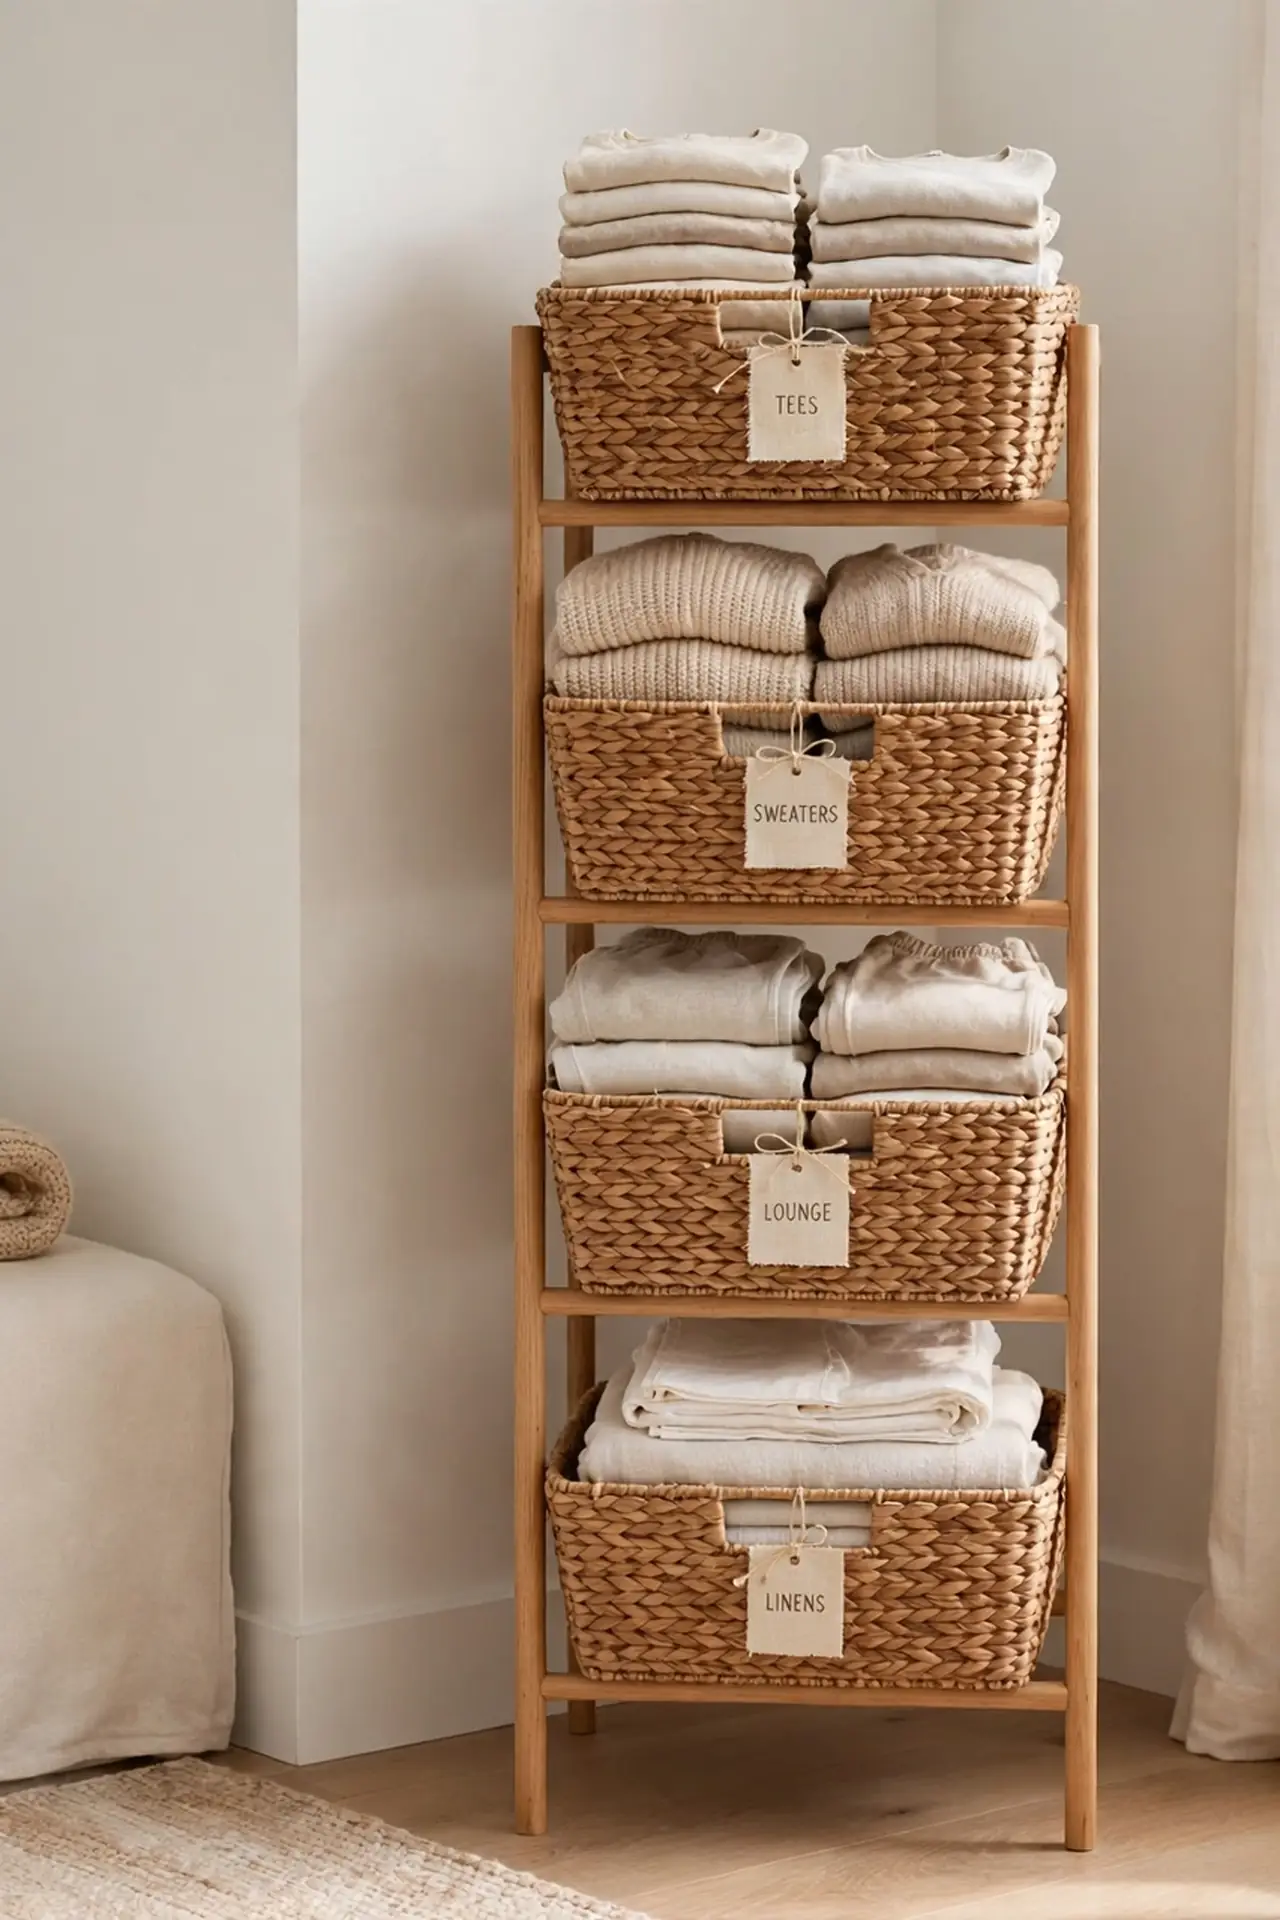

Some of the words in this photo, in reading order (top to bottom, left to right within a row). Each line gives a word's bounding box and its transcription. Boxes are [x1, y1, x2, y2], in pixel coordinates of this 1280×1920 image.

[775, 394, 819, 415] TEES
[753, 803, 839, 824] SWEATERS
[764, 1202, 831, 1222] LOUNGE
[765, 1592, 826, 1614] LINENS
